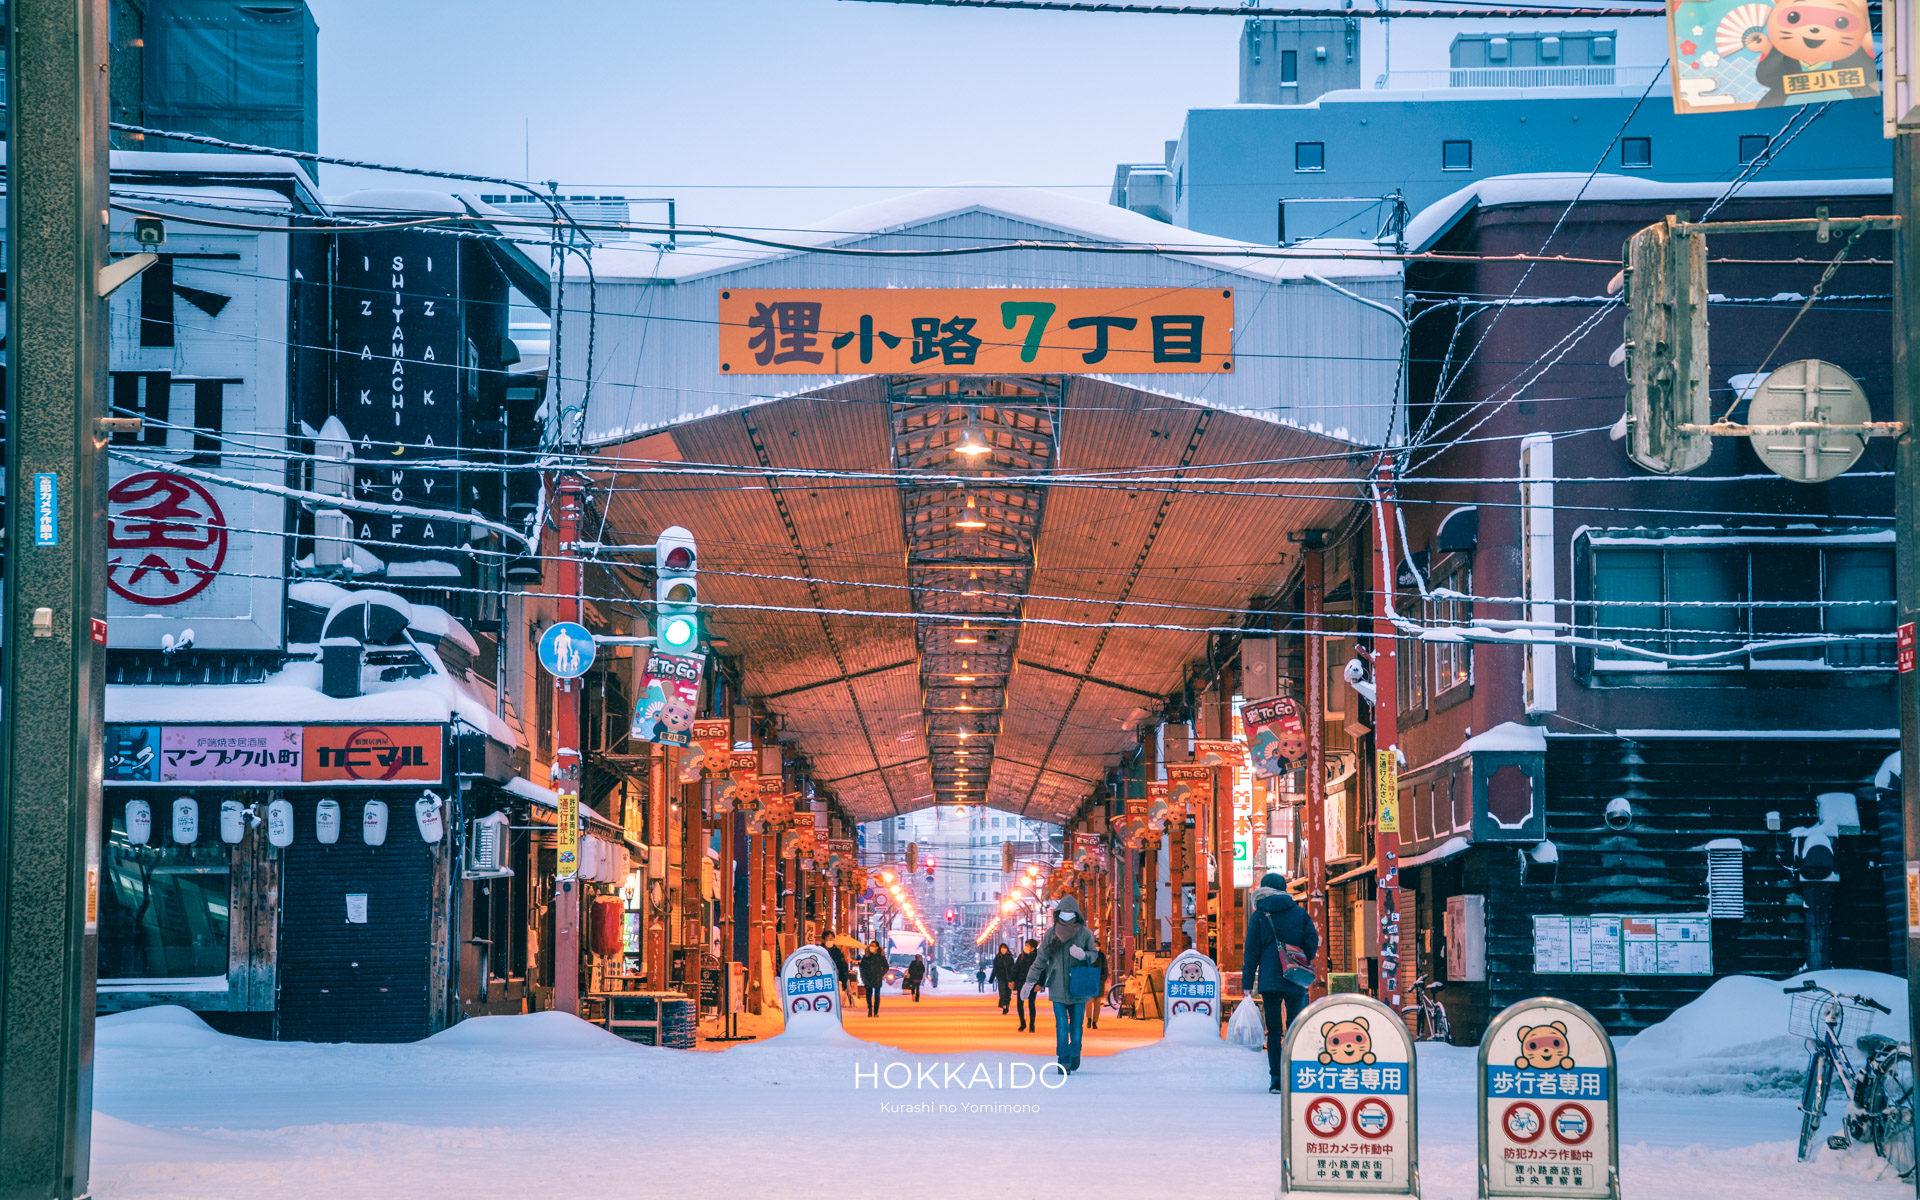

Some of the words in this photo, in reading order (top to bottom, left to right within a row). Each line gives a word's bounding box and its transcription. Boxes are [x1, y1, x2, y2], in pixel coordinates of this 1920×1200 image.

[1787, 71, 1861, 92] 狸小路
[392, 256, 404, 426] SHITAMACHI
[748, 301, 1205, 365] 狸小路7丁目
[109, 252, 244, 467] 下町
[361, 256, 372, 538] IZAKAYA
[423, 256, 435, 538] IZAKAYA
[39, 475, 52, 541] 防犯カメラ作動中
[392, 470, 404, 538] WOF
[197, 738, 268, 748] 炉端焼き居酒屋
[163, 749, 300, 767] マンプク小町
[316, 746, 429, 767] カニマル
[559, 798, 568, 845] 通行禁止
[788, 977, 833, 994] 歩行者専用
[1170, 984, 1214, 996] 歩行者専用
[1296, 1067, 1402, 1091] 歩行者専用
[1493, 1071, 1600, 1096] 歩行者専用
[1306, 1142, 1394, 1156] 防犯カメラ作動中
[1504, 1147, 1593, 1161] 防犯カメラ作動中
[1317, 1160, 1383, 1170] 狸小路商店街
[1317, 1169, 1383, 1180] 中央警察署
[1515, 1165, 1582, 1176] 狸小路商店街
[1515, 1175, 1583, 1187] 中央警察署
